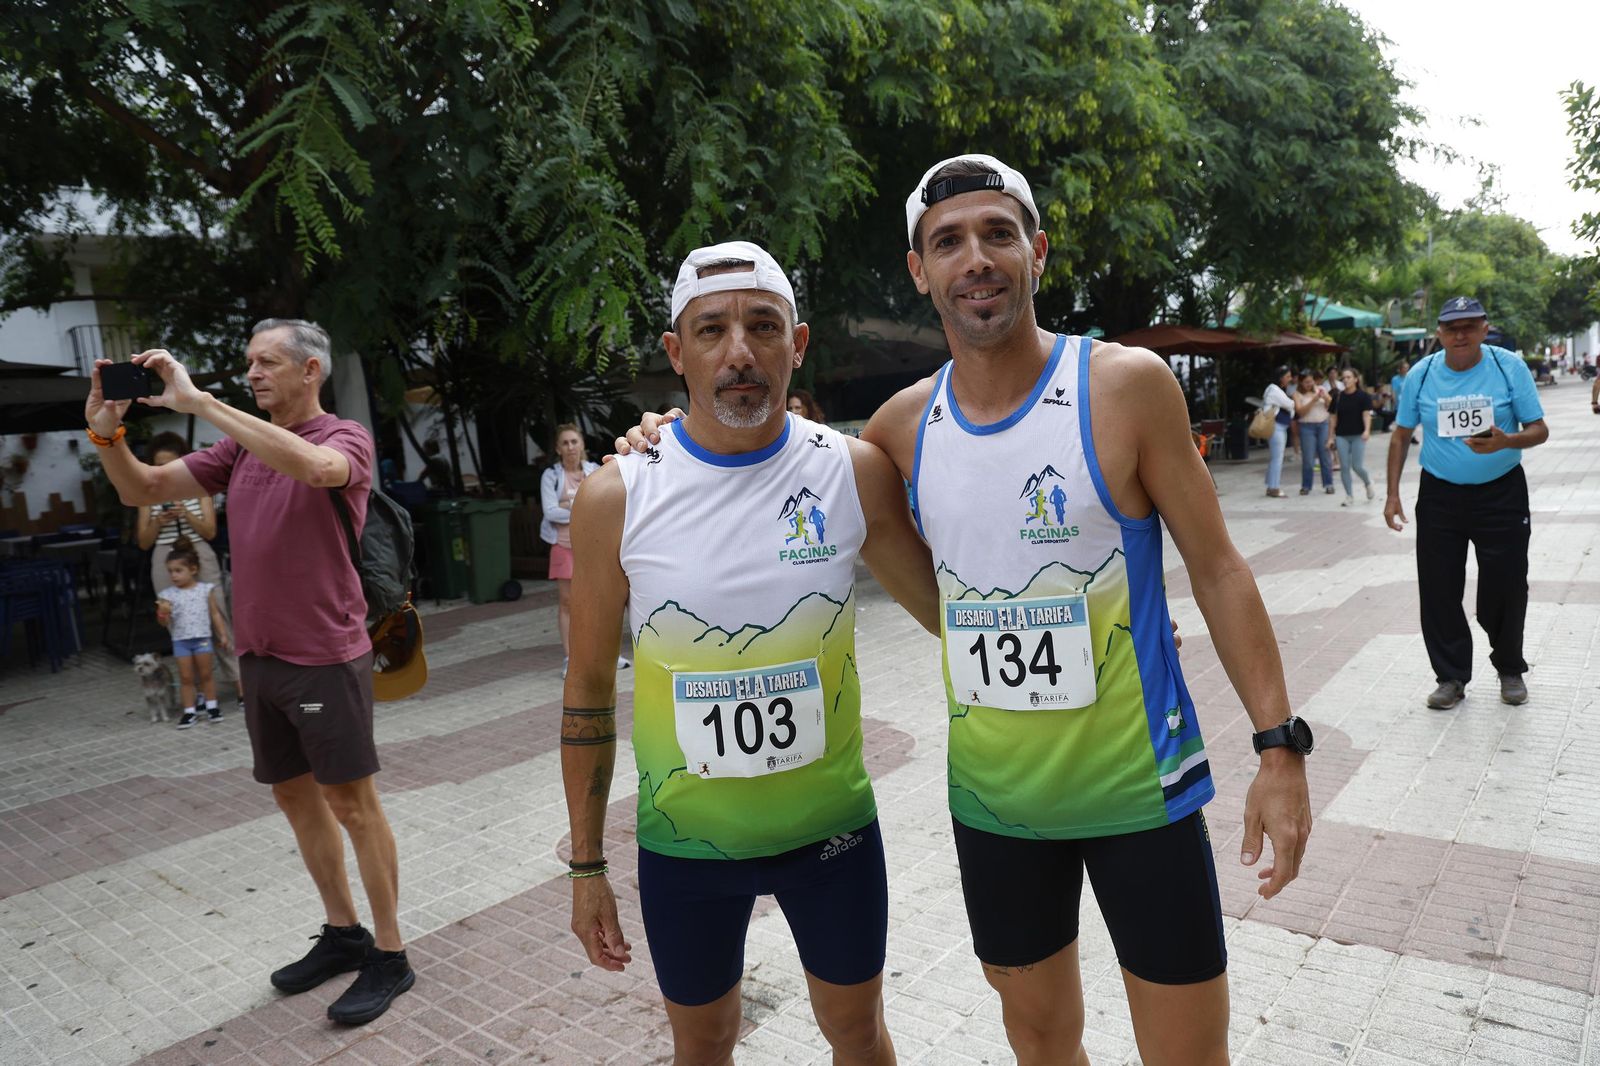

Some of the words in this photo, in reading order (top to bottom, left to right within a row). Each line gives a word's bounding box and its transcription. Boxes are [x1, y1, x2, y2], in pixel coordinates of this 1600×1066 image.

[1447, 409, 1483, 429] 195
[1020, 526, 1080, 540] FACINAS
[779, 545, 837, 561] FACINAS
[955, 607, 995, 627] DESAFÍO
[997, 605, 1029, 631] ELA
[1029, 605, 1073, 626] TARIFA
[969, 630, 1062, 687] 134
[685, 678, 731, 698] DESAFÍO
[734, 673, 767, 701] ELA
[767, 670, 808, 692] TARIFA
[1039, 694, 1069, 702] TARIFA
[702, 697, 797, 757] 103
[776, 754, 803, 766] TARIFA
[820, 834, 863, 861] adidas
